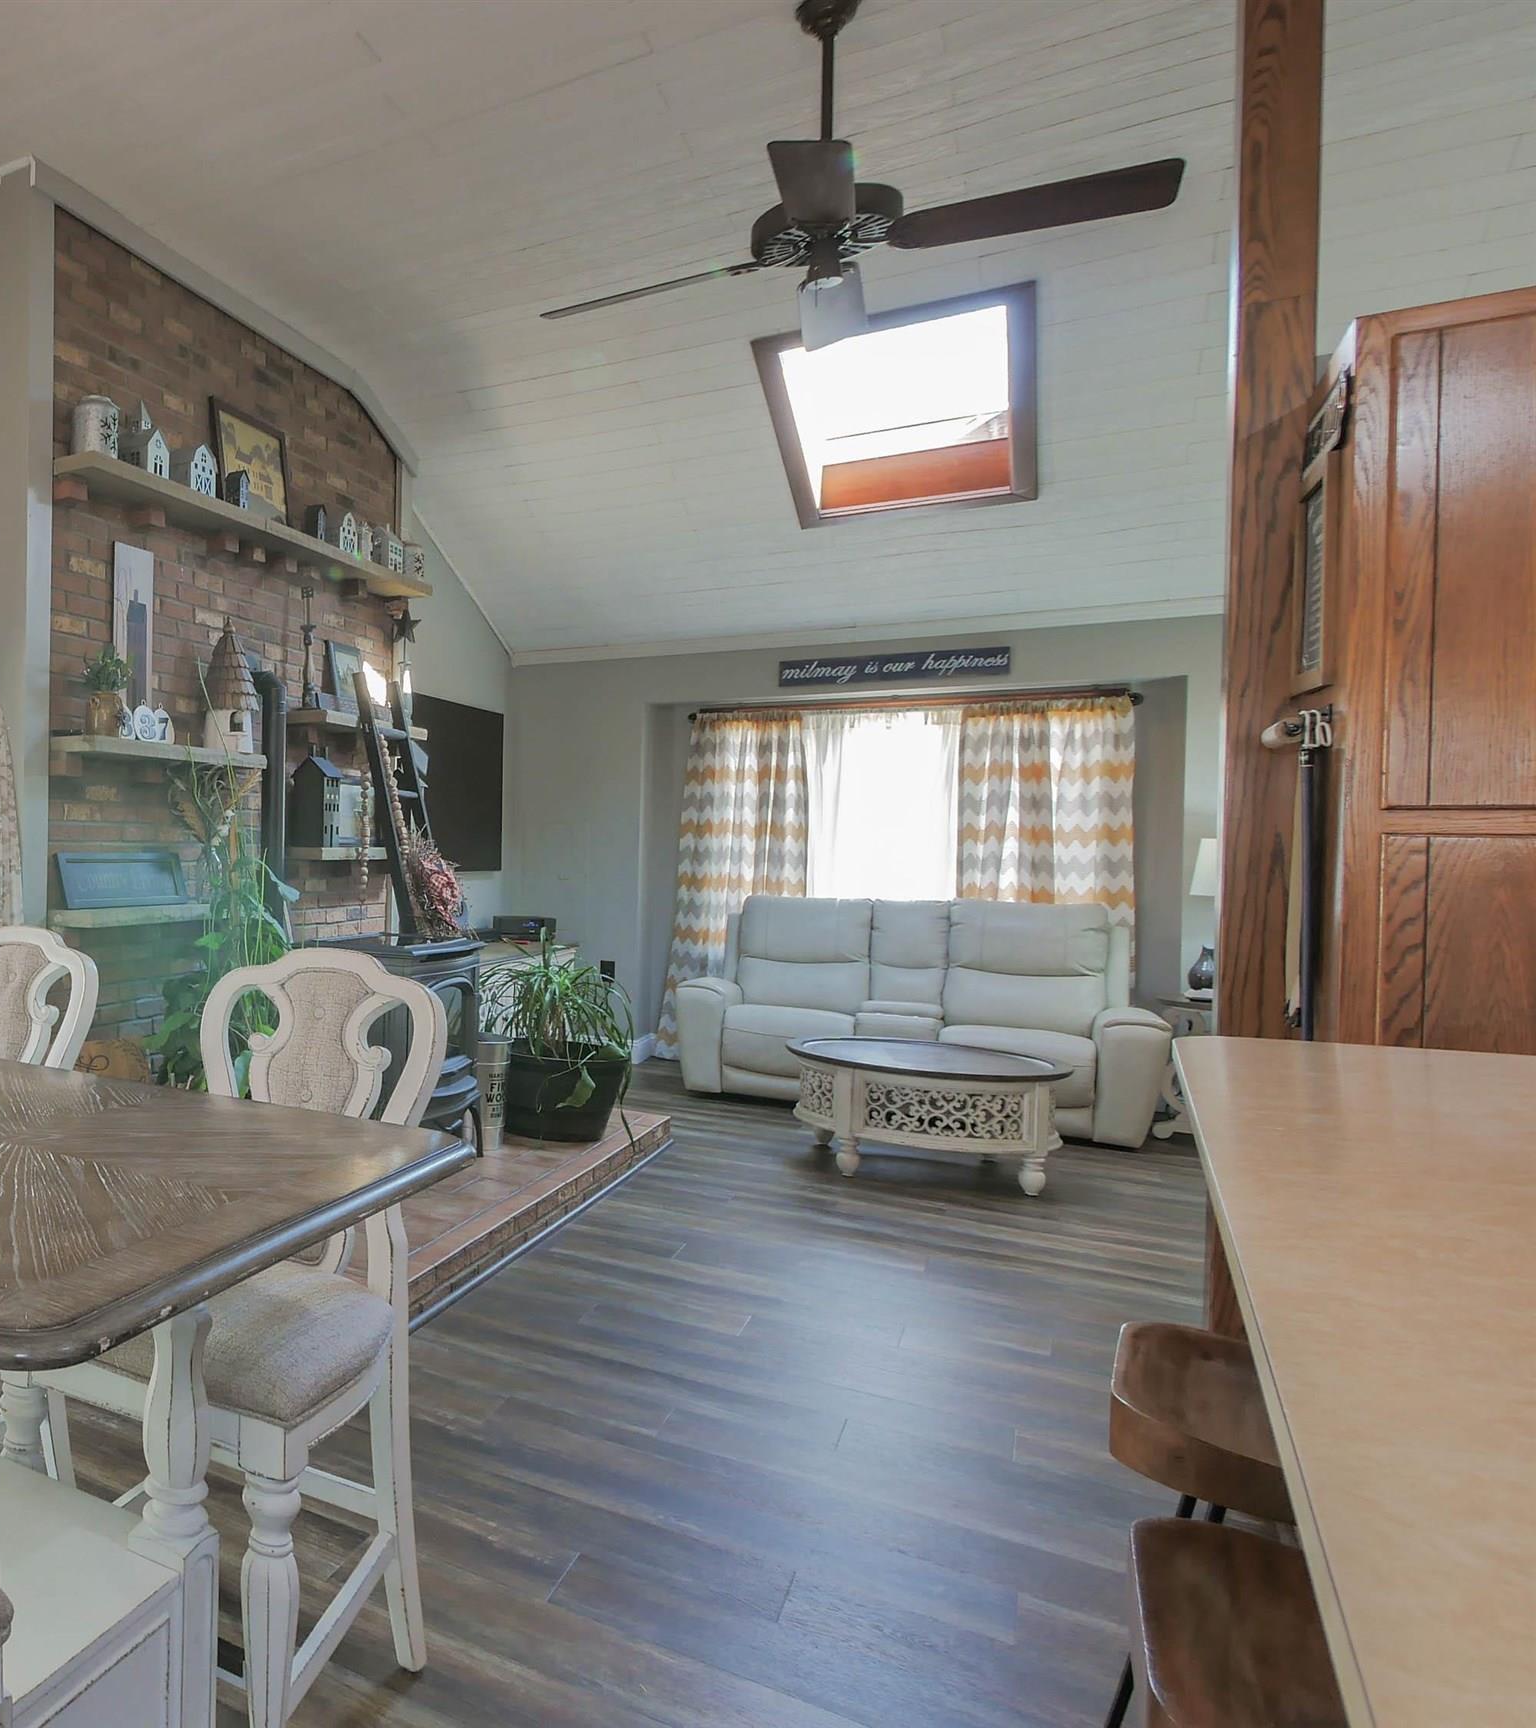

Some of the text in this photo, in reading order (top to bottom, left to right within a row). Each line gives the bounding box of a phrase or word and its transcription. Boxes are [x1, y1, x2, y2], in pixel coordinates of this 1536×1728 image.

[781, 652, 1009, 685] milmay is our happiness
